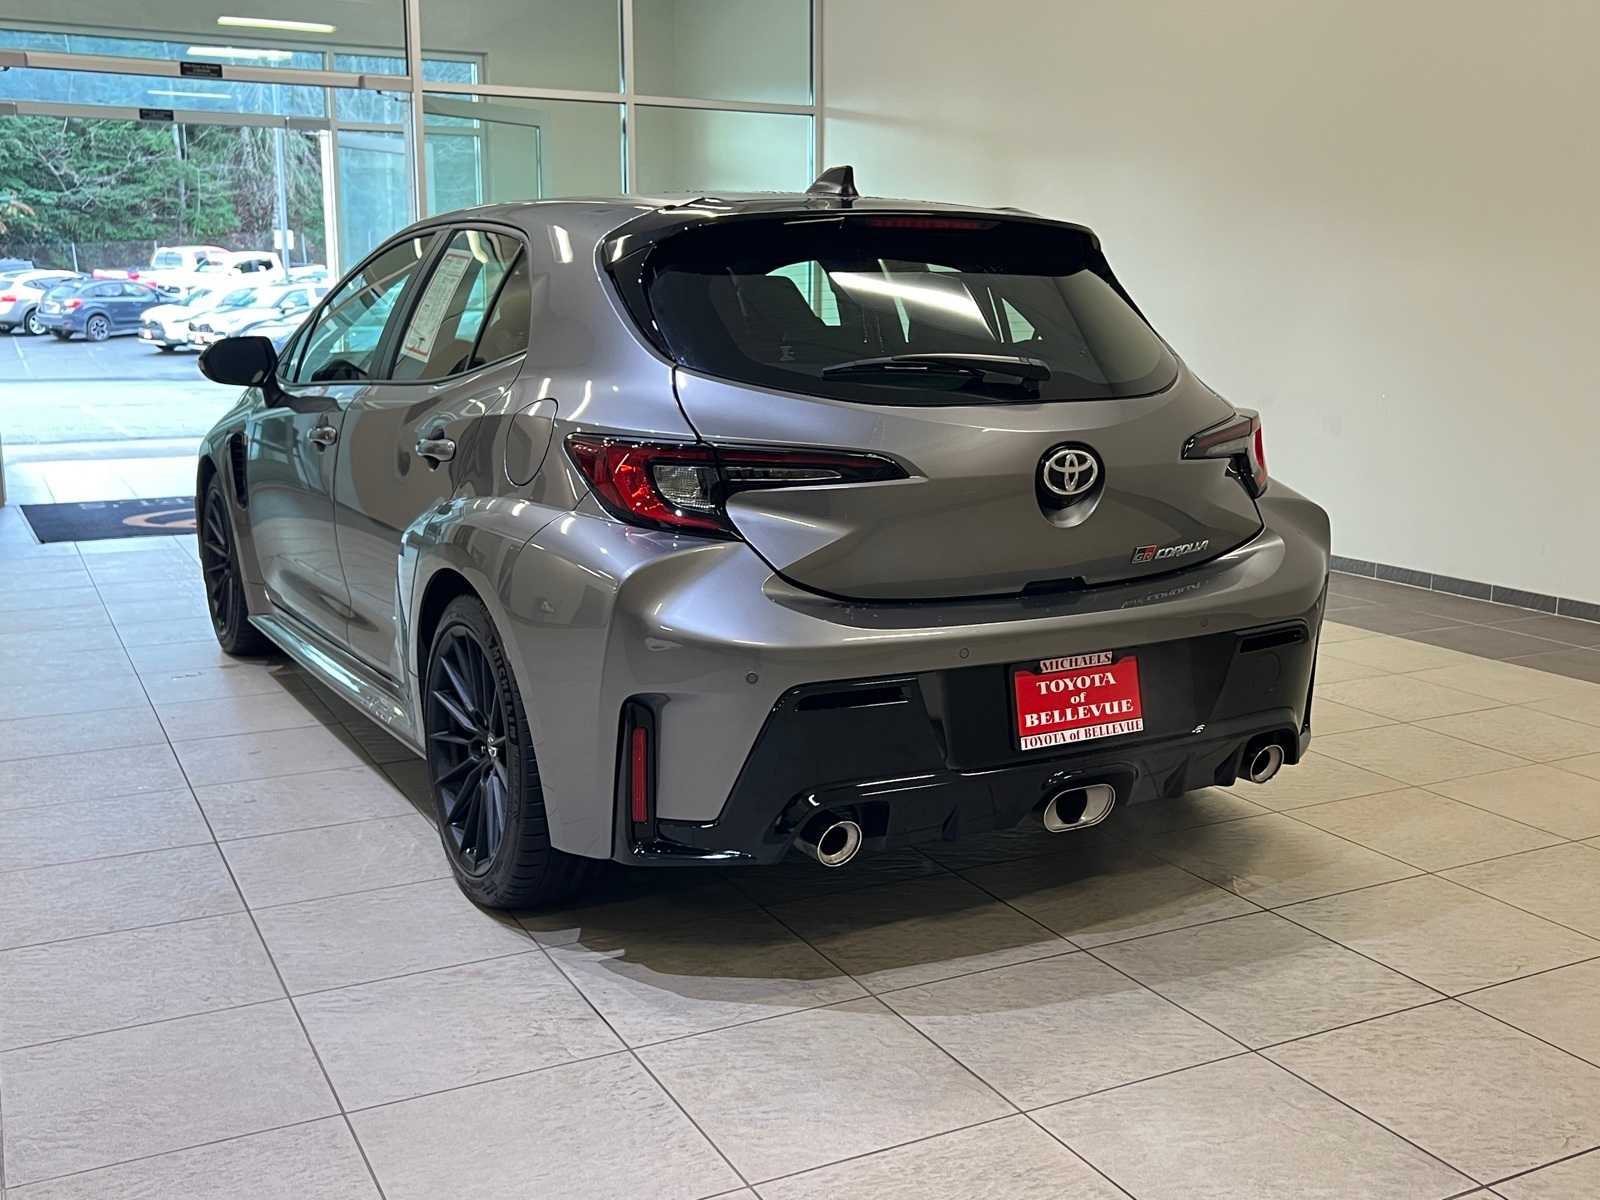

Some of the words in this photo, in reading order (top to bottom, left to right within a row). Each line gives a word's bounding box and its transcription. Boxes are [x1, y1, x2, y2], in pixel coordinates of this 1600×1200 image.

[1155, 540, 1209, 559] COROLLA
[1042, 653, 1111, 671] MICHAELS
[1036, 672, 1117, 695] TOYOTA
[1070, 691, 1087, 704] of
[1024, 699, 1134, 728] BELLEVUE
[1022, 733, 1066, 749] TOYOTA
[1069, 731, 1080, 742] of
[1085, 719, 1142, 739] BELLEVUE
